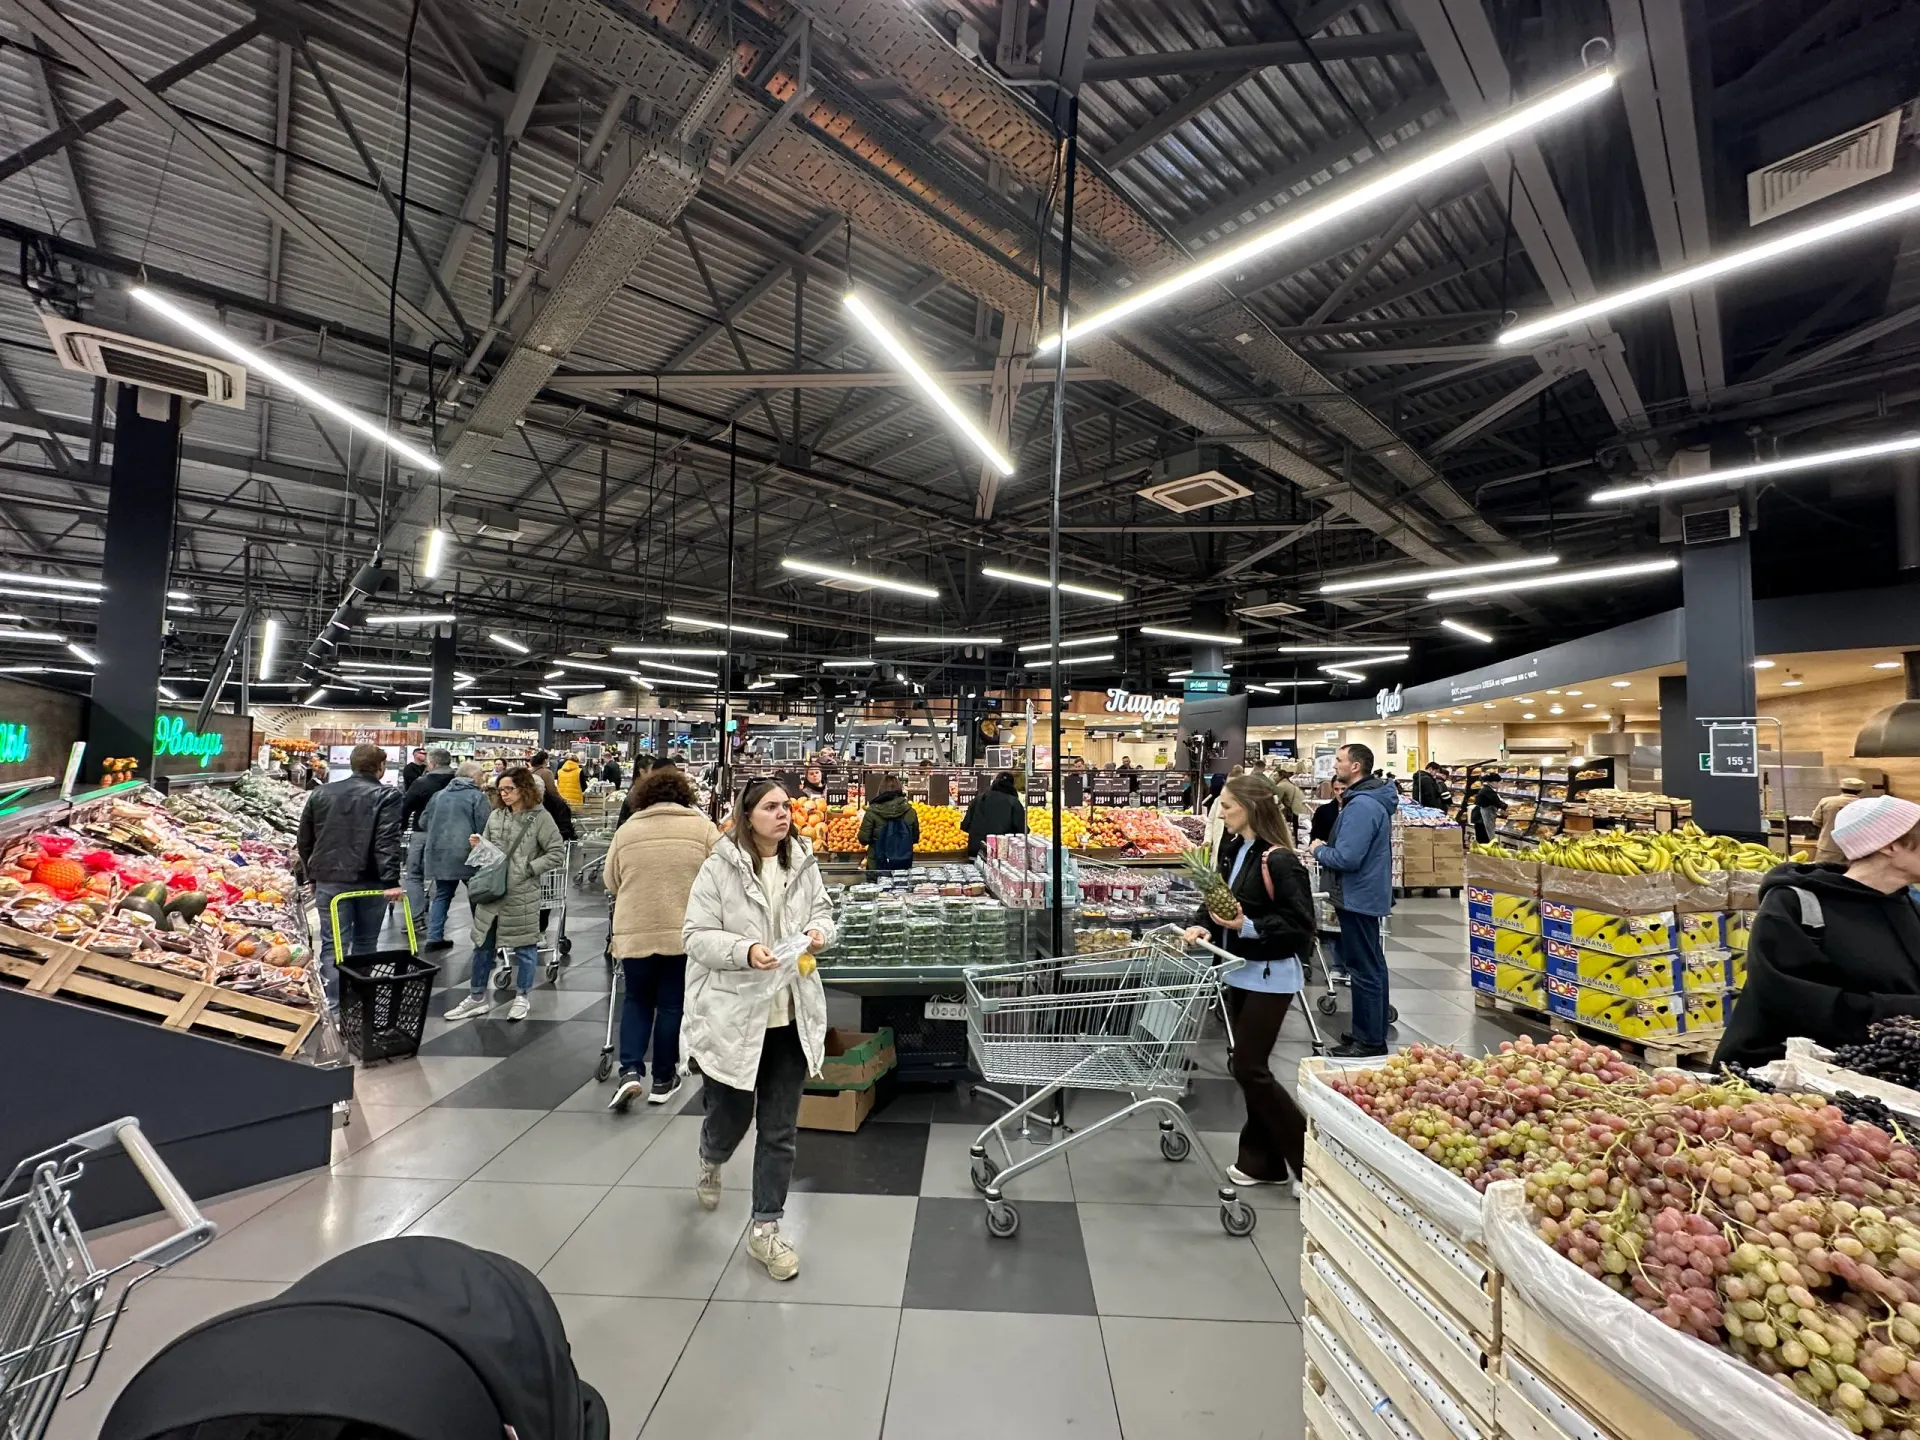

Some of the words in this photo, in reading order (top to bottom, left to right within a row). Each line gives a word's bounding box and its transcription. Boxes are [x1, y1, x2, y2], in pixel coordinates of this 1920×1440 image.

[1106, 688, 1180, 722] Пицца
[1376, 683, 1402, 720] Хлеб
[154, 715, 224, 768] Овощи
[1726, 756, 1744, 766] 155
[1469, 887, 1494, 903] Dole
[1543, 902, 1573, 920] Dole
[1471, 921, 1496, 938] Dole
[1495, 917, 1525, 929] BANANAS
[1548, 940, 1578, 960] Dole
[1576, 936, 1613, 950] BANANAS
[1472, 956, 1497, 974] Dole
[1497, 953, 1529, 966] BANANAS
[1549, 977, 1578, 997] Dole
[1581, 976, 1621, 992] BANANAS
[1497, 988, 1529, 1003] BANANAS
[1580, 1013, 1619, 1031] BANANAS
